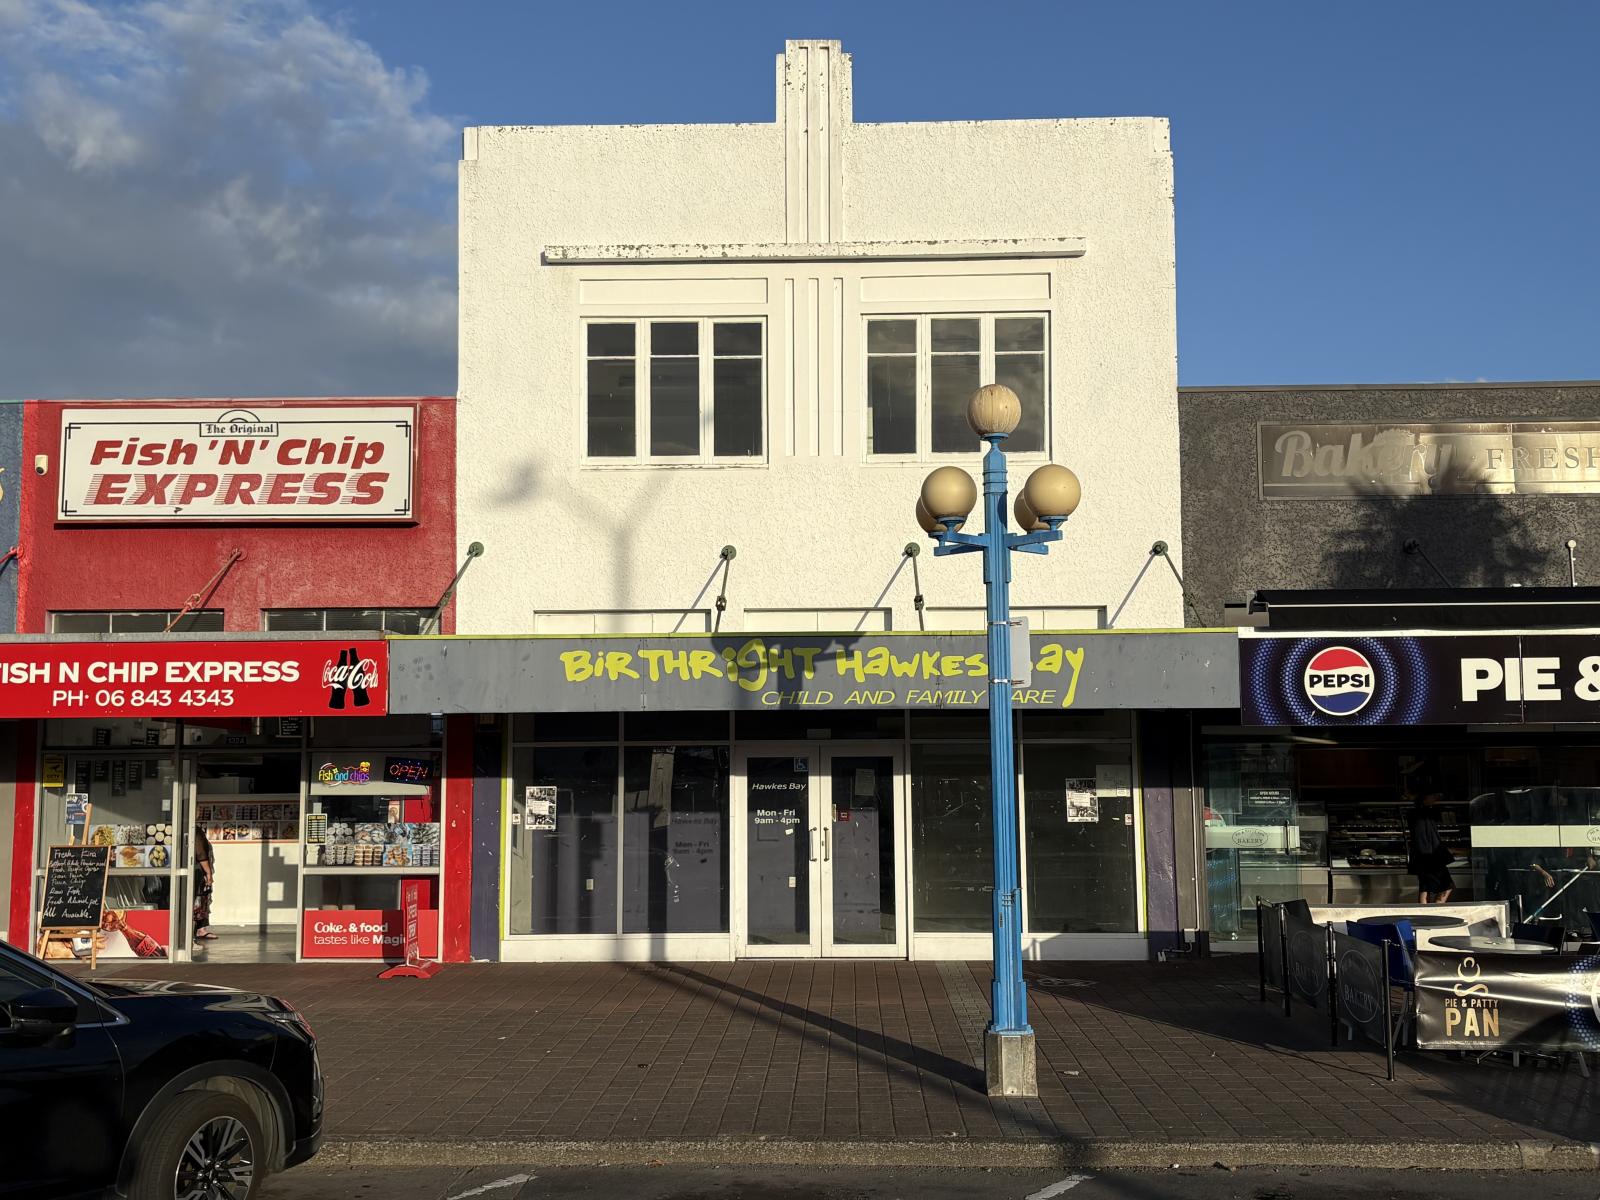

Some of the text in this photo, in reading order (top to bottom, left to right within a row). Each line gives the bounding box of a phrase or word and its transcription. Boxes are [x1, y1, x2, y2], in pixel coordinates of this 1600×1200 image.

[205, 423, 273, 435] The Original
[90, 436, 199, 466] Fish
[276, 435, 385, 470] Chip
[83, 471, 390, 506] EXPRESS
[0, 659, 300, 684] ISH N CHIP EXPRESS
[321, 658, 379, 690] Coca-Cola
[1030, 643, 1084, 708] ay
[1460, 656, 1562, 702] PIE
[1308, 672, 1371, 689] PEPSI
[95, 689, 126, 707] 06
[131, 689, 172, 707] 843
[178, 688, 235, 707] 4343
[761, 689, 1057, 705] CHILD AND FAMILY ARE
[318, 769, 370, 783] Fish and chips
[389, 764, 429, 780] OPEN
[751, 782, 807, 791] Hawkes Bay
[756, 809, 776, 817] Mon
[783, 809, 796, 817] Fri
[754, 817, 774, 825] 9am
[780, 817, 801, 826] 4pm
[43, 907, 56, 919] All
[348, 922, 358, 933] &
[359, 922, 389, 933] food
[313, 934, 405, 947] tastes like Magi
[1445, 998, 1499, 1008] PIE & PATTY
[1445, 1007, 1500, 1037] PAN
